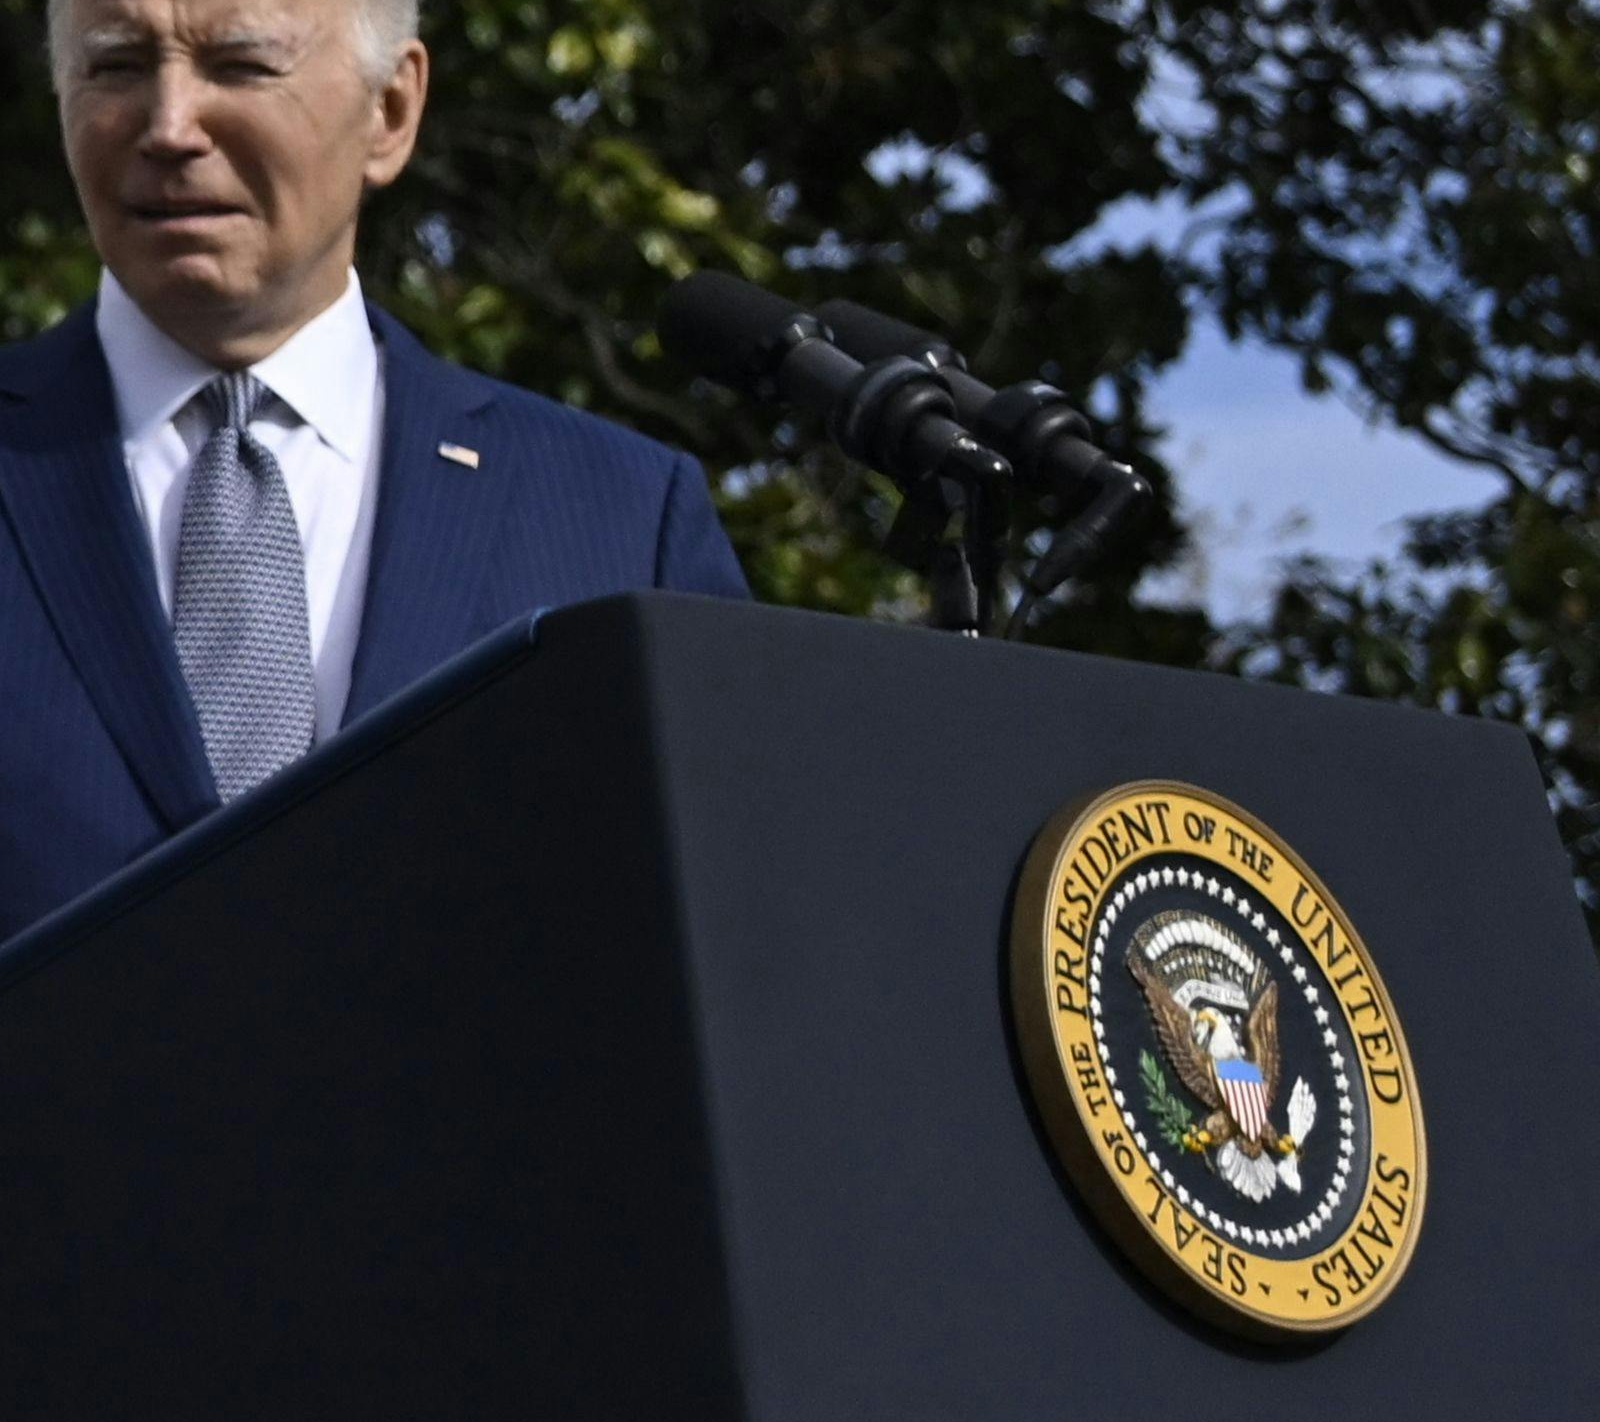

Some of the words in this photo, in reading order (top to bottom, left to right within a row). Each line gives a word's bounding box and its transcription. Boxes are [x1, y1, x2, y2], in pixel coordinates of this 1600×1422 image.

[1183, 811, 1217, 845] OF
[1225, 826, 1275, 884] THE
[1054, 801, 1171, 1021] PRESIDENT
[1291, 882, 1404, 1104] UNITED
[1071, 1042, 1108, 1117] THE
[1102, 1129, 1136, 1176] OF
[1145, 1176, 1248, 1297] SEAL
[1311, 1152, 1411, 1307] STATES
